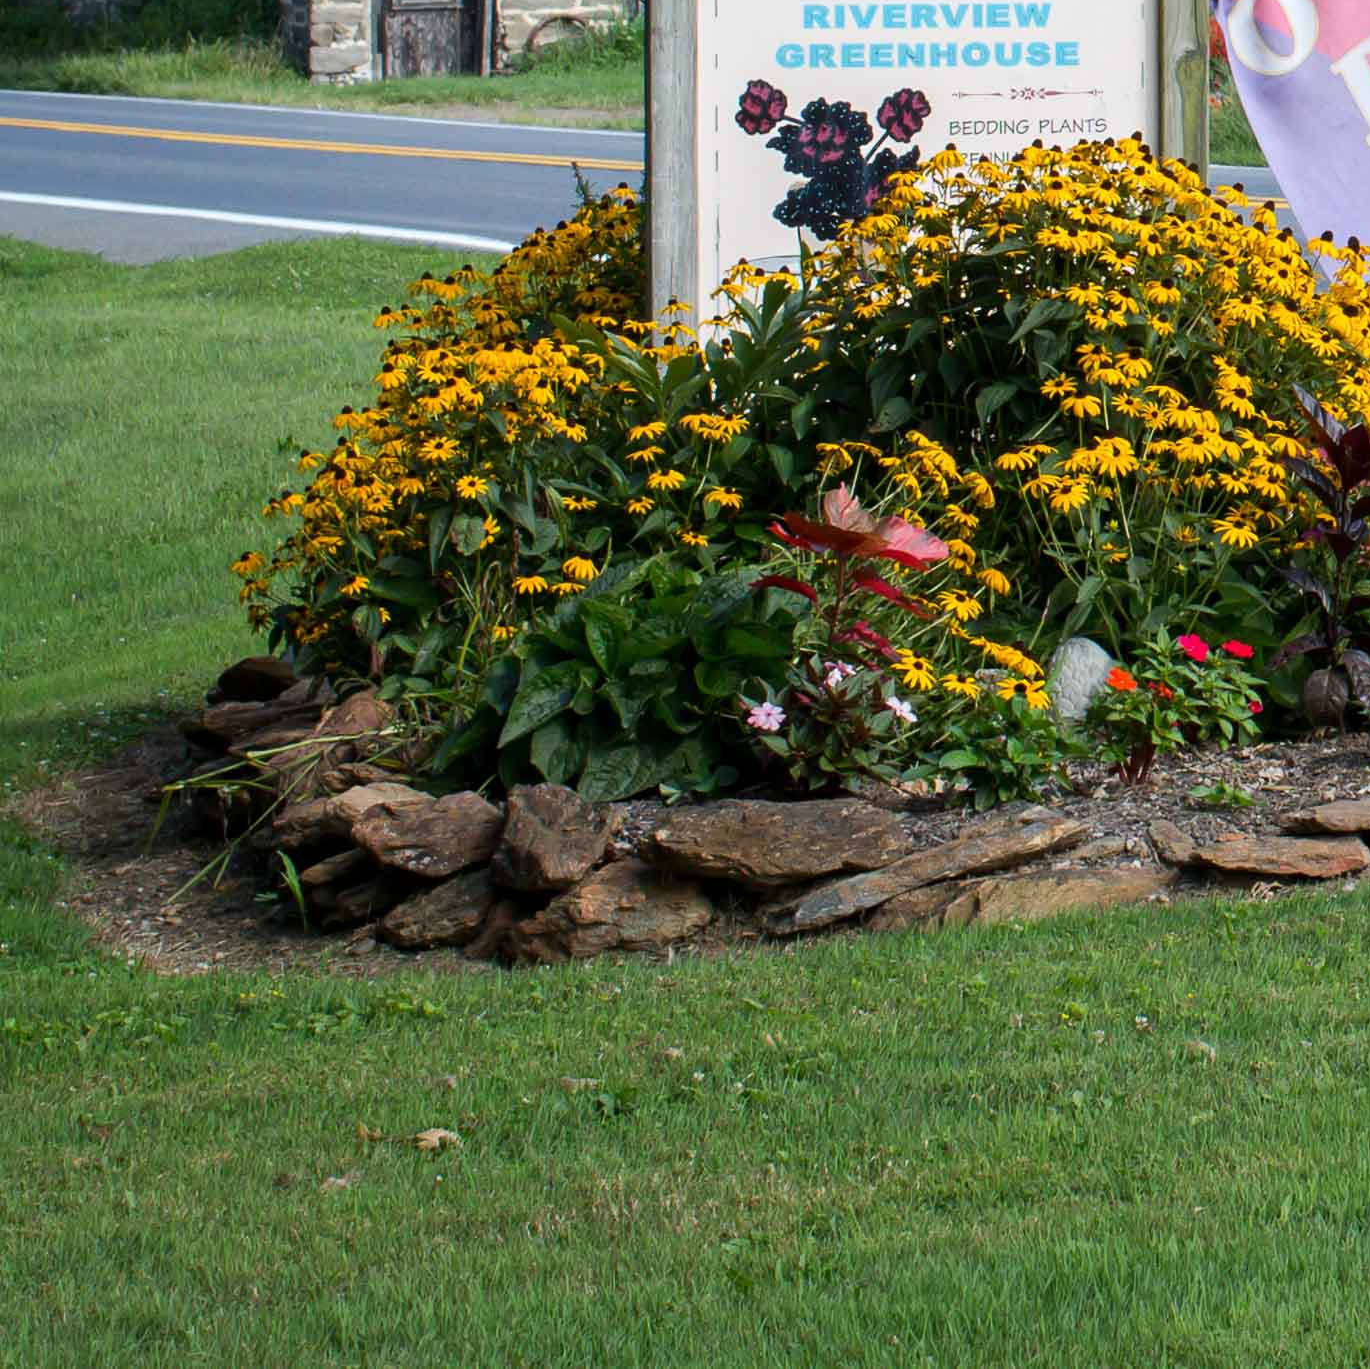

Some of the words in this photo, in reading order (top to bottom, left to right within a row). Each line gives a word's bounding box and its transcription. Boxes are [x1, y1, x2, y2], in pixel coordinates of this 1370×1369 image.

[802, 1, 1052, 30] RIVERVIEW
[774, 40, 1081, 69] GREENHOUSE
[948, 118, 1031, 136] BEDDING
[1038, 117, 1108, 134] PLANTS
